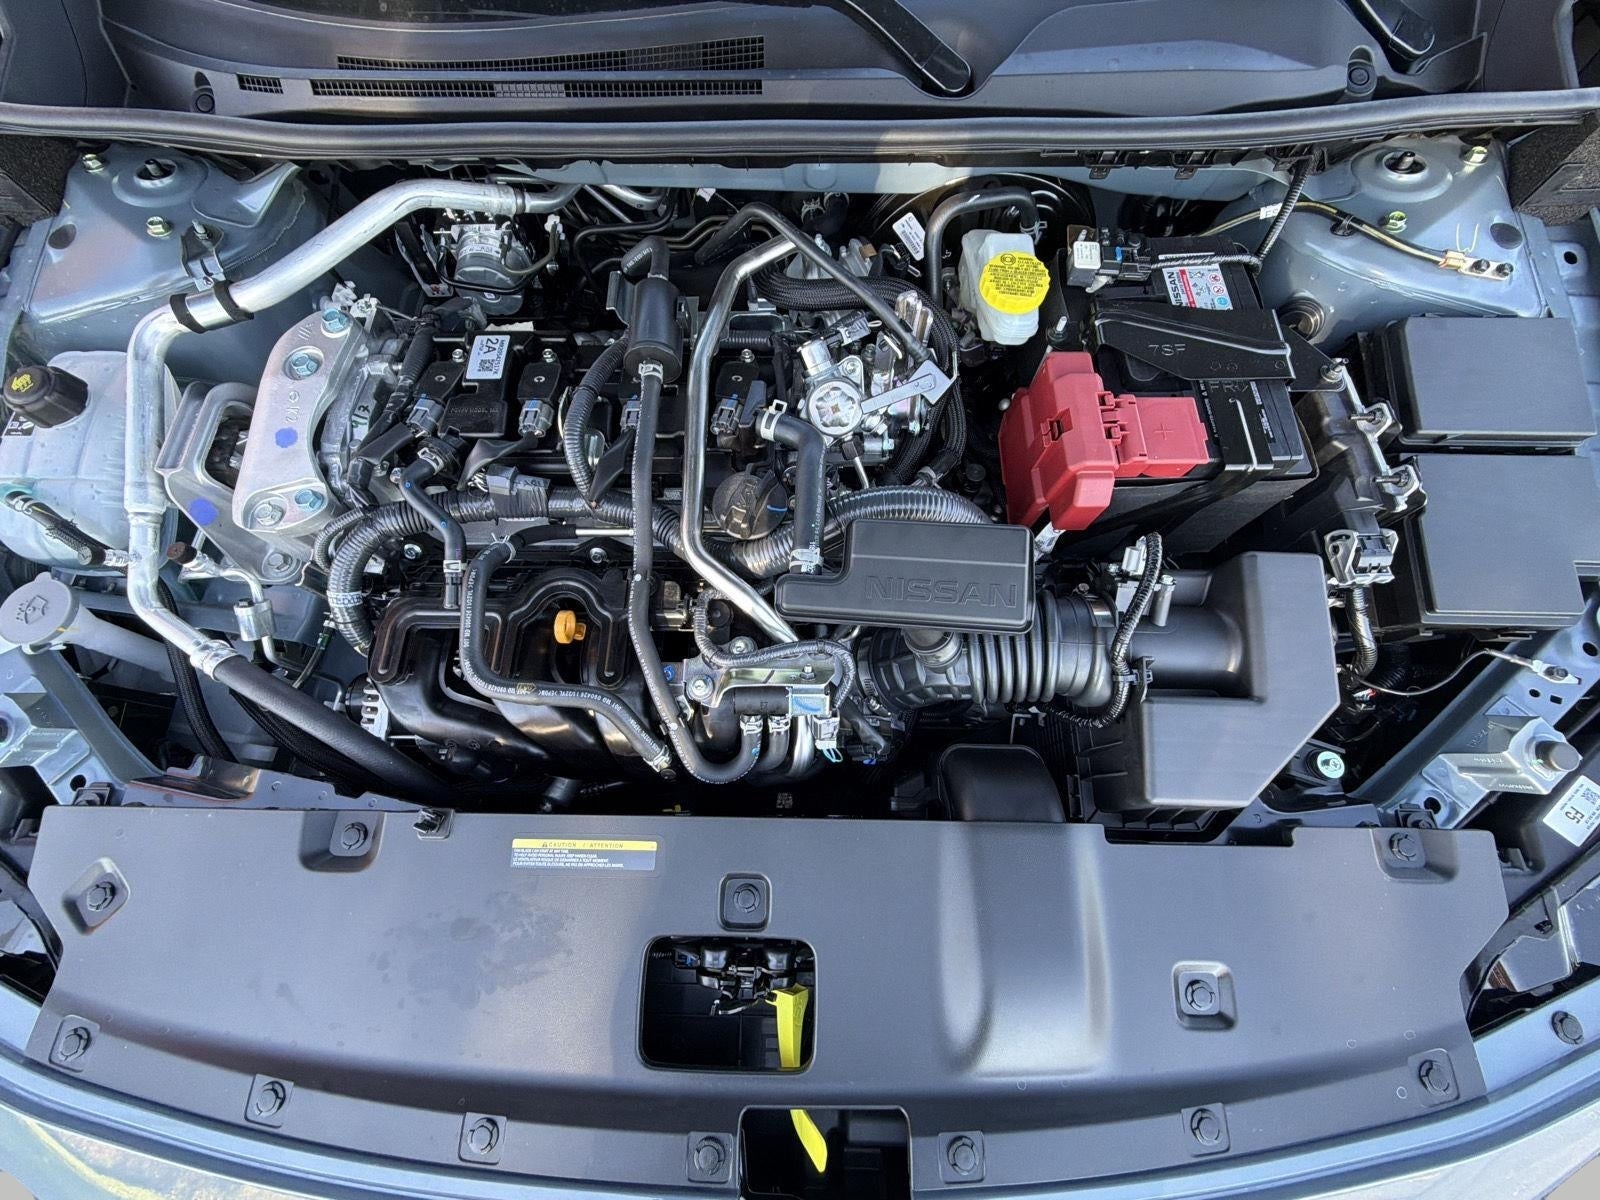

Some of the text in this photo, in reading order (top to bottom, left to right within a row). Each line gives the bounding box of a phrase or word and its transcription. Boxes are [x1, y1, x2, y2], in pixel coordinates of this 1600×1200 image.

[483, 338, 499, 354] 2A
[866, 575, 1017, 609] NISSAN
[1564, 806, 1585, 824] F5
